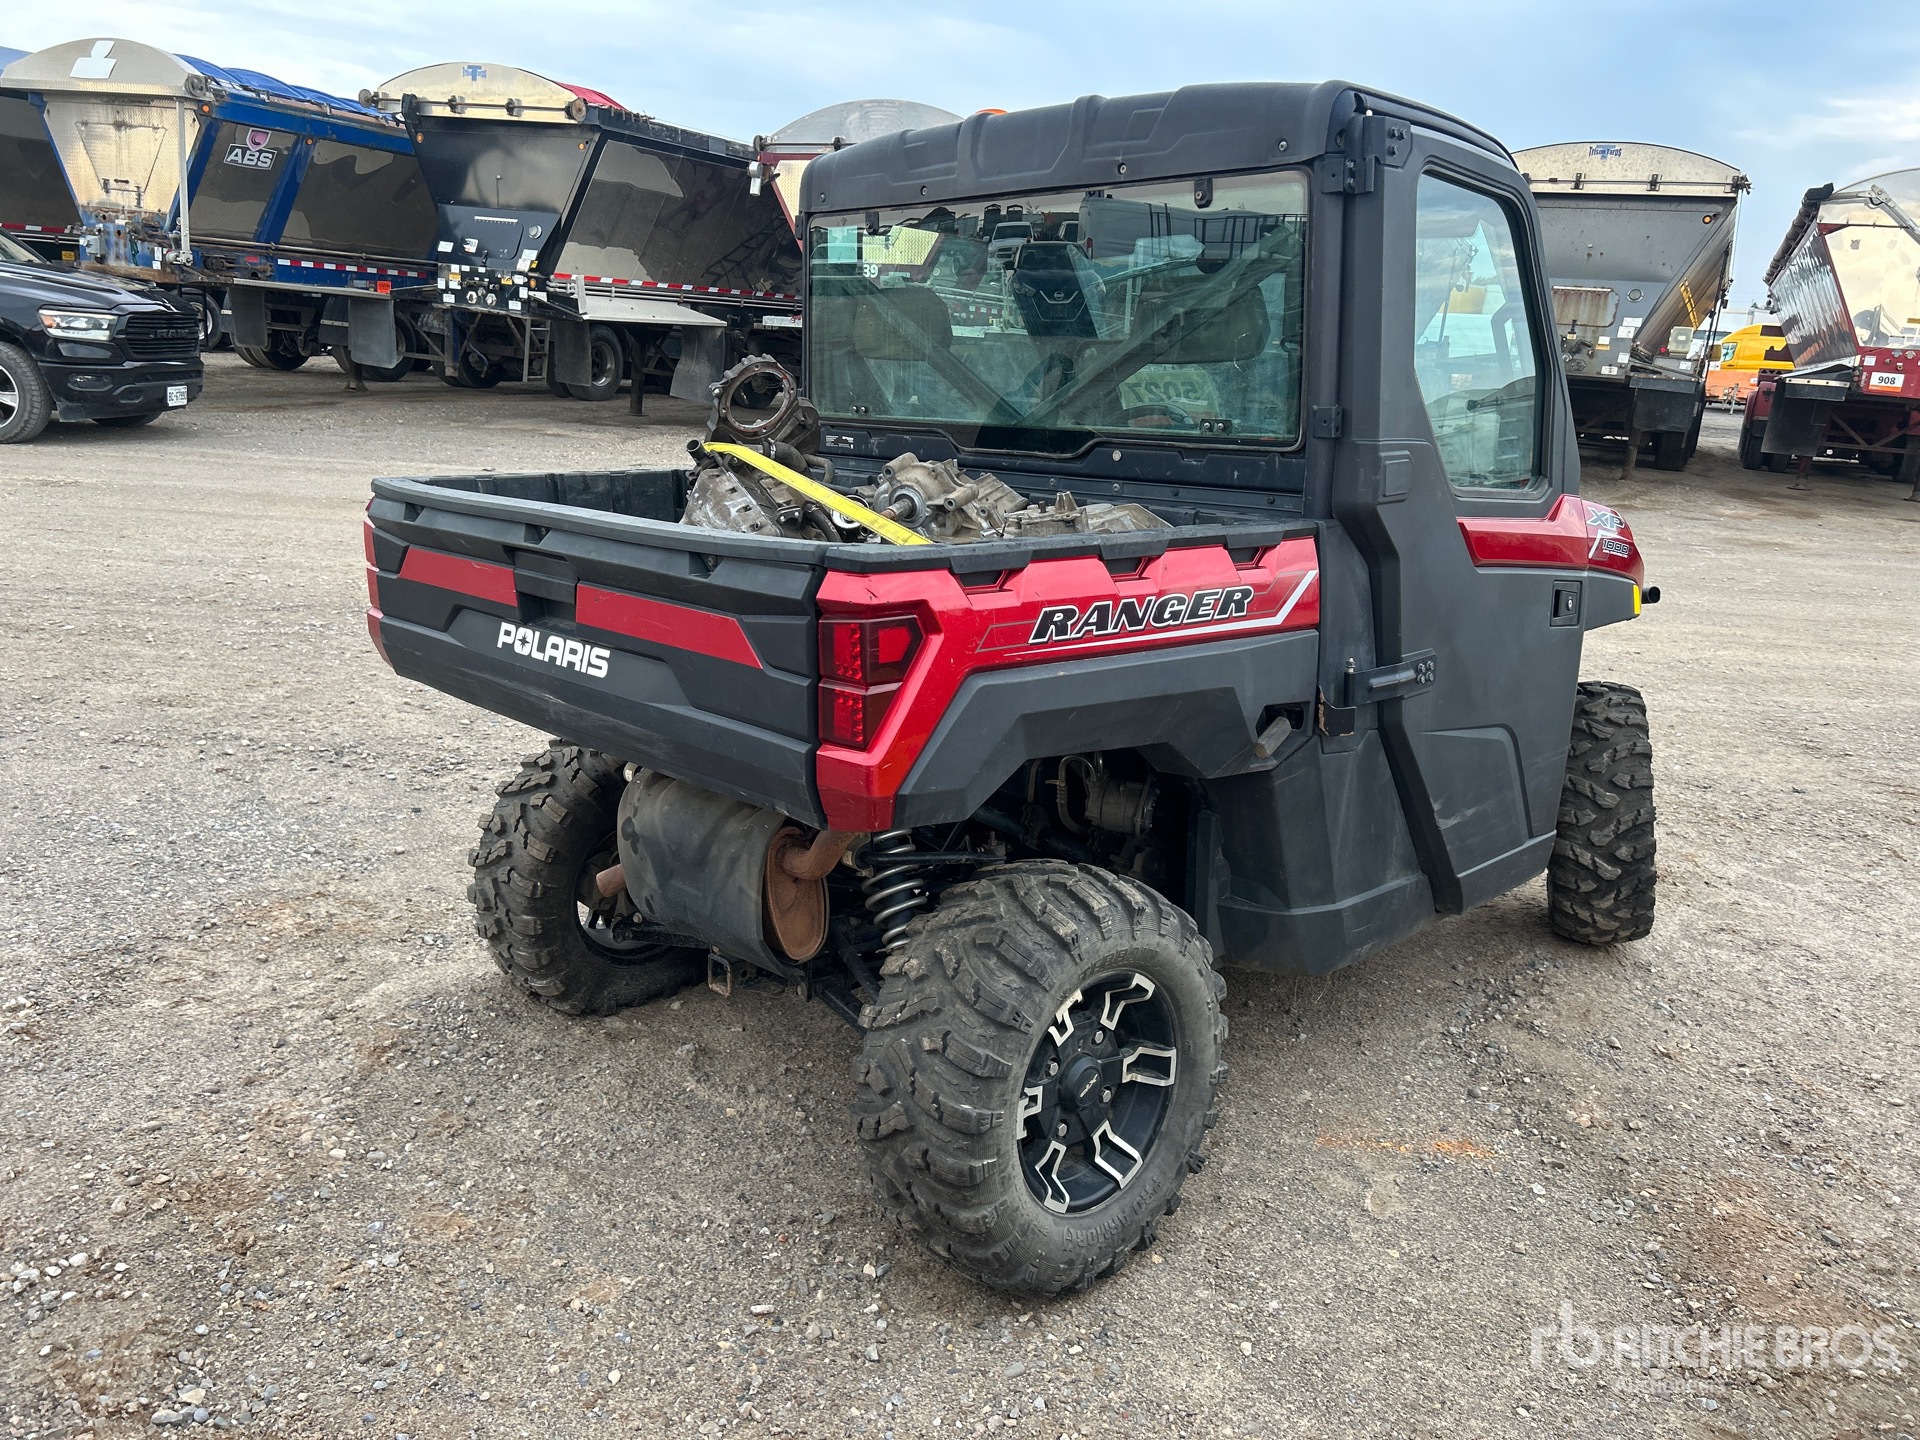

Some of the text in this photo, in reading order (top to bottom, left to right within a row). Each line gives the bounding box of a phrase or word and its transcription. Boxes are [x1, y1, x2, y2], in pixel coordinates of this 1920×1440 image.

[227, 149, 272, 168] ABS
[156, 329, 188, 338] RAM
[1878, 376, 1896, 385] 908
[1586, 507, 1624, 531] XP
[1603, 539, 1629, 554] 1000
[1028, 586, 1253, 644] RANGER
[497, 622, 611, 678] POLARIS
